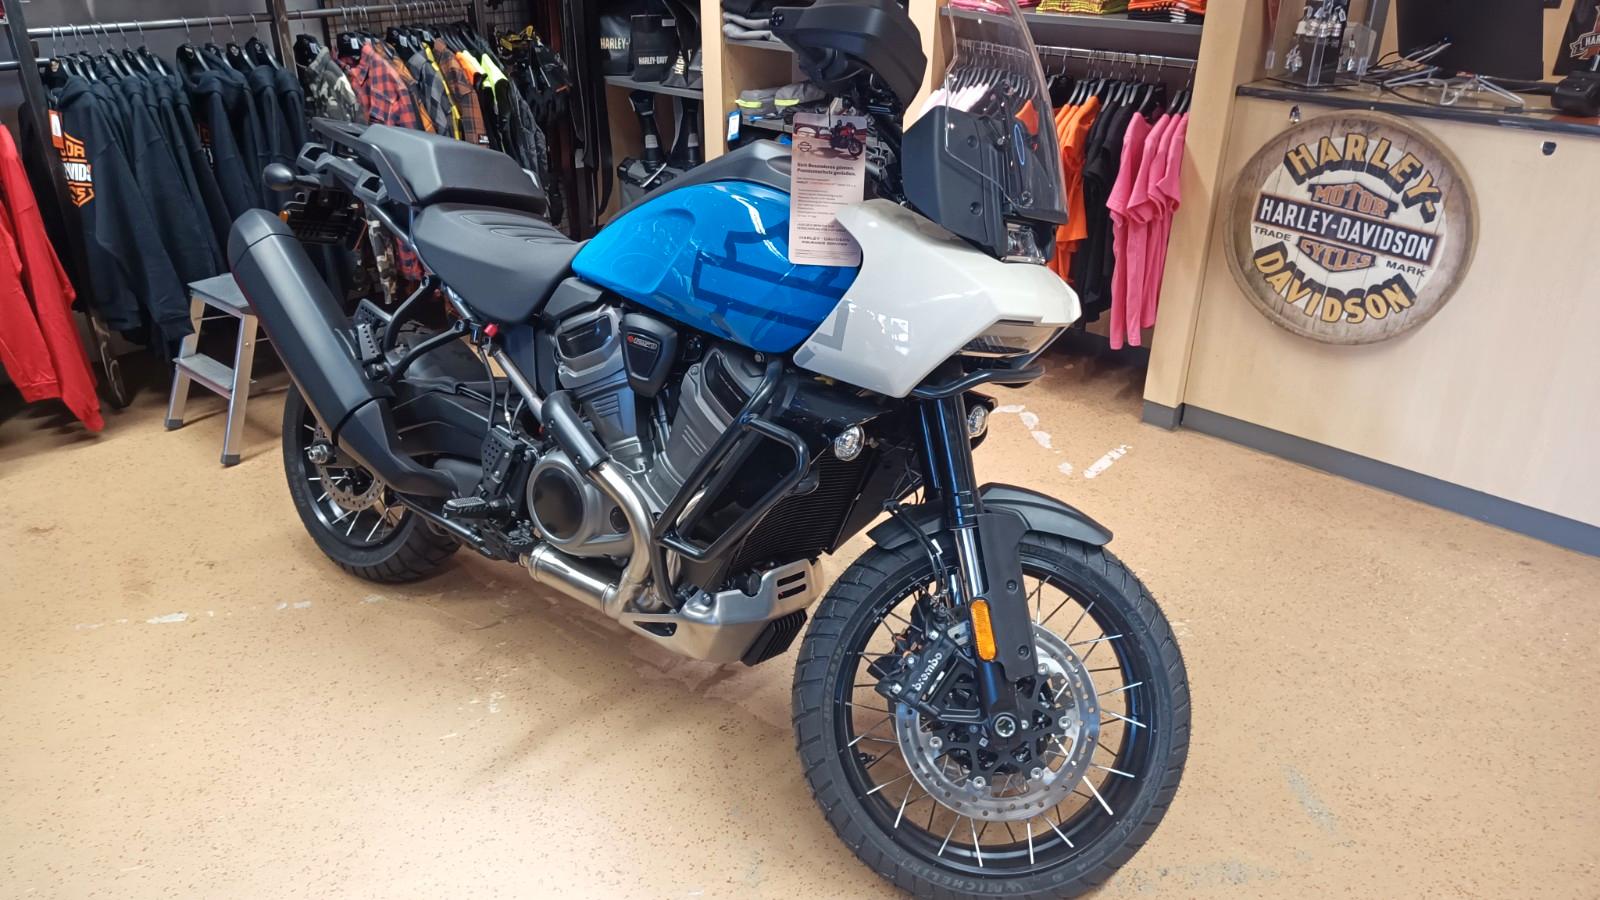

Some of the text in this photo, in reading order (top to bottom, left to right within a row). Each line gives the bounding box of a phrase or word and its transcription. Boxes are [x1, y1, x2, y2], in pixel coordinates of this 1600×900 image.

[1313, 184, 1389, 217] MOTOR
[1254, 226, 1426, 277] TRADE MARK
[1260, 198, 1434, 262] HARLEY-DAVIDSON
[1300, 240, 1372, 270] CYCLES
[1254, 245, 1416, 324] DAVIDSON
[911, 652, 942, 691] brembo
